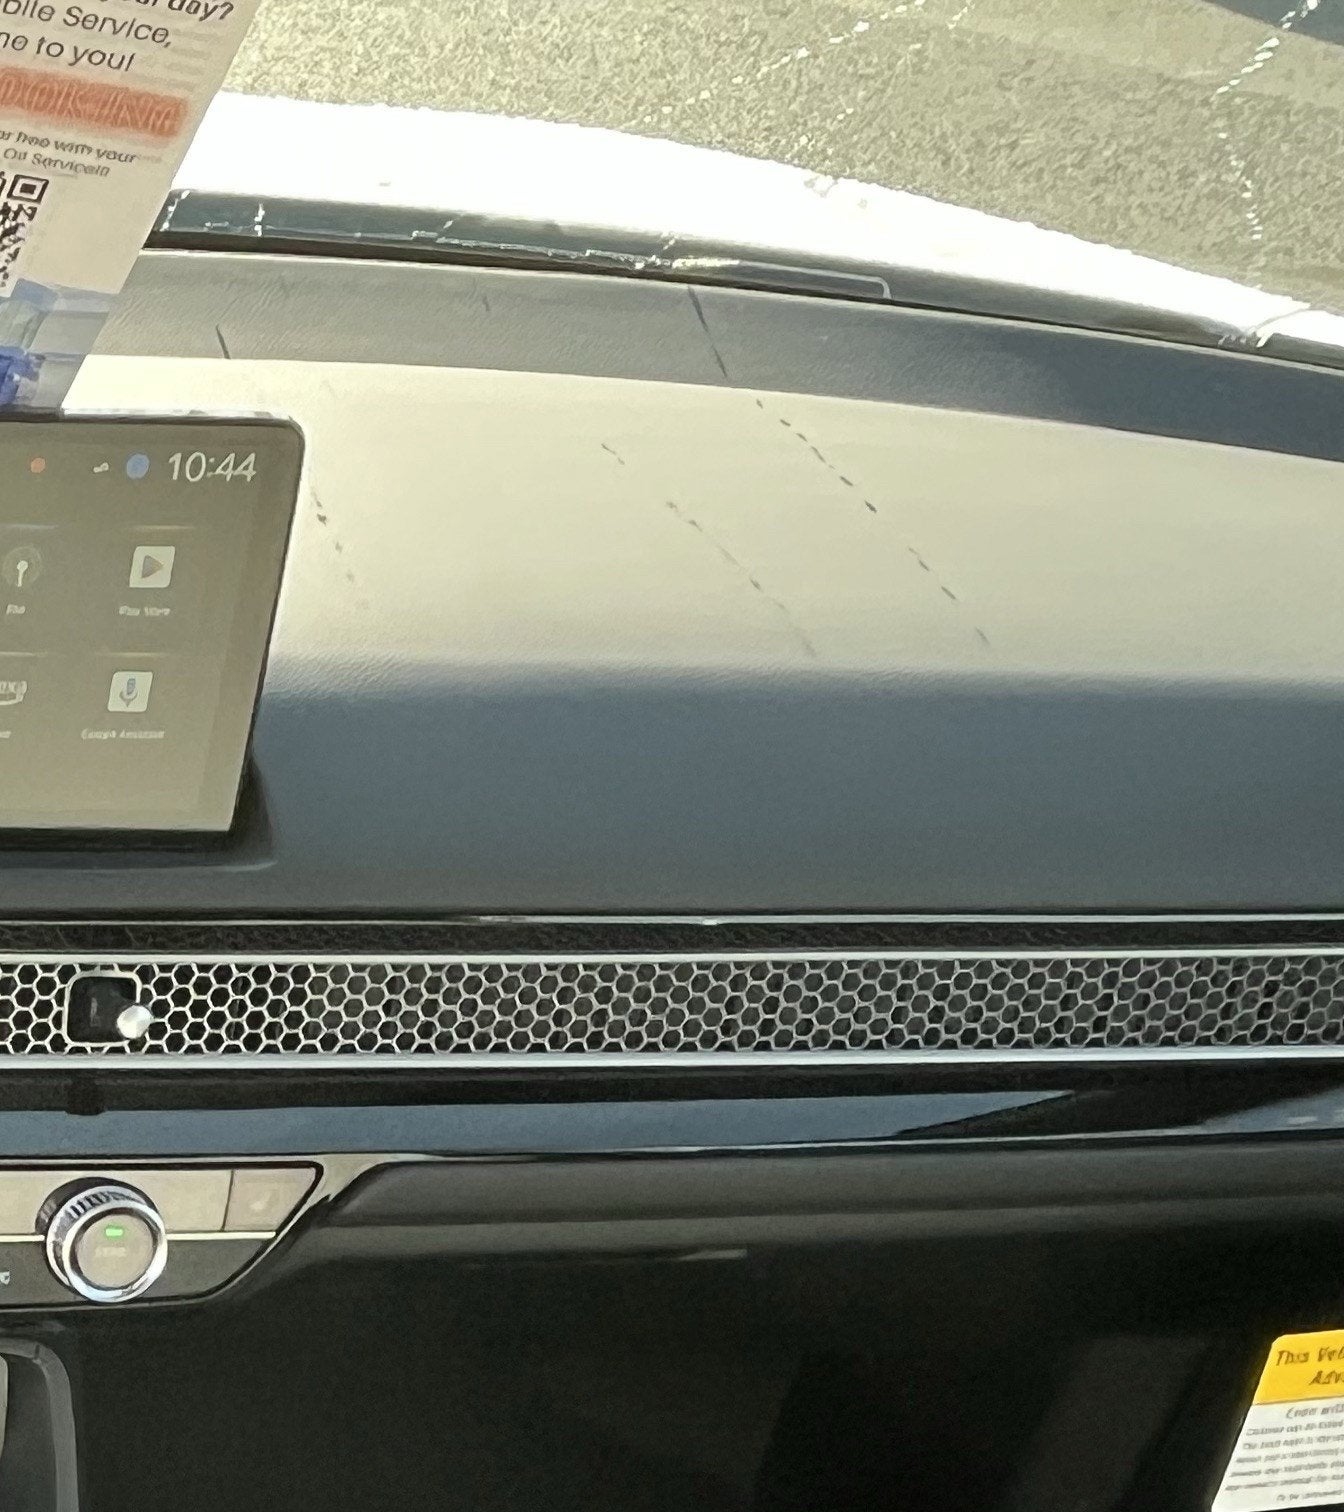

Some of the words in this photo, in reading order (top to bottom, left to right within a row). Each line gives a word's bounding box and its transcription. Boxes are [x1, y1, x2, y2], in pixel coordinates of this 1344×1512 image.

[63, 5, 172, 49] Service,
[35, 36, 65, 58] to
[68, 45, 136, 72] you!
[169, 451, 257, 483] 10:44
